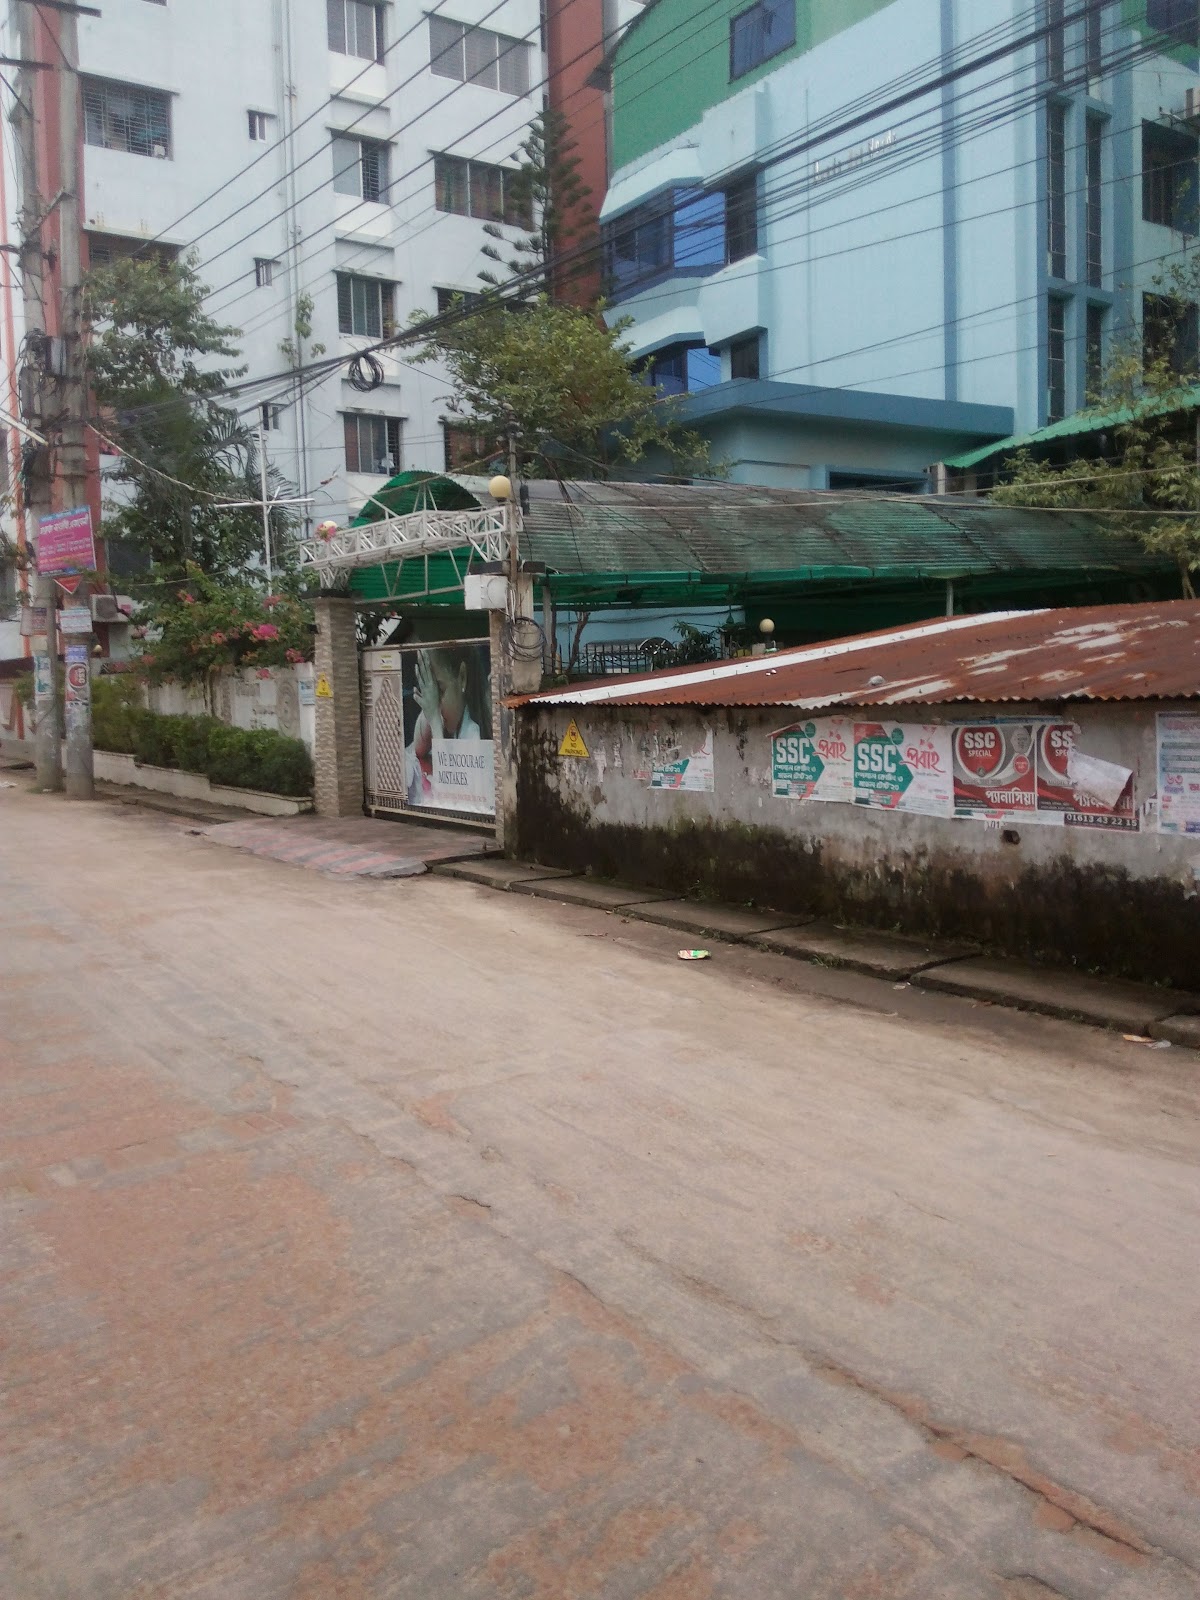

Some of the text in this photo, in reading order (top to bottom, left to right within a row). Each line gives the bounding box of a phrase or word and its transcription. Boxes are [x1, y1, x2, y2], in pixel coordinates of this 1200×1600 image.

[964, 731, 995, 749] SSC
[1051, 730, 1073, 748] SS
[776, 737, 810, 764] SSC
[813, 739, 852, 762] প্রবাহ
[857, 743, 896, 773] SSC
[437, 751, 485, 769] WE ENCOURAGE
[899, 747, 946, 773] প্রবাহ
[985, 787, 1036, 805] প্যানাসিয়া
[1066, 813, 1137, 827] 01613 43 22 15
